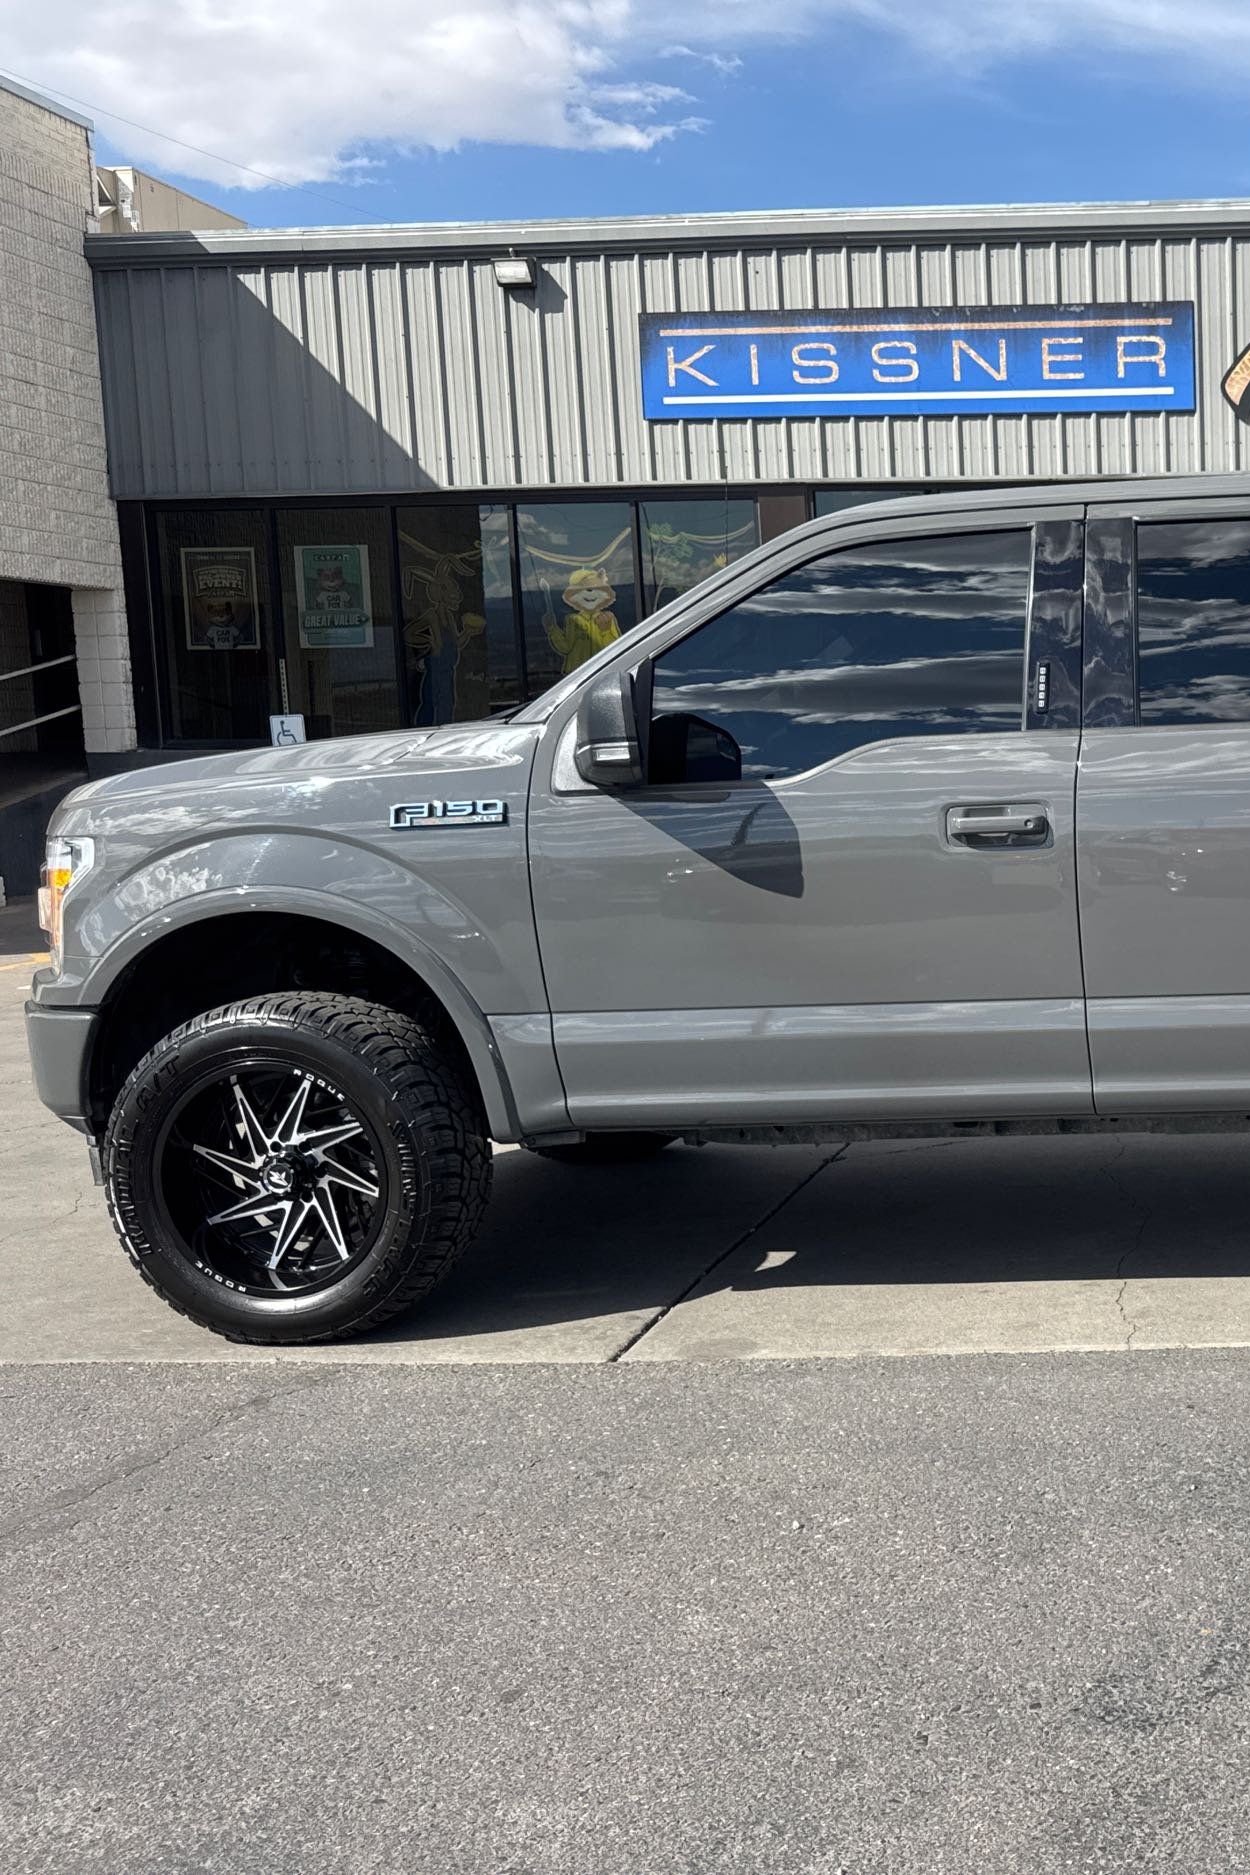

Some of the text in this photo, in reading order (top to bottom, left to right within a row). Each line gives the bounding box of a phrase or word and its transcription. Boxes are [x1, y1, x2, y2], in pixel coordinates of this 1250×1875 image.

[665, 335, 1167, 388] KISSNER
[304, 615, 332, 628] GREAT
[333, 613, 361, 627] VALUE
[472, 814, 499, 823] XLT
[293, 1068, 346, 1102] ROGUE
[195, 1259, 247, 1294] ROGUE
